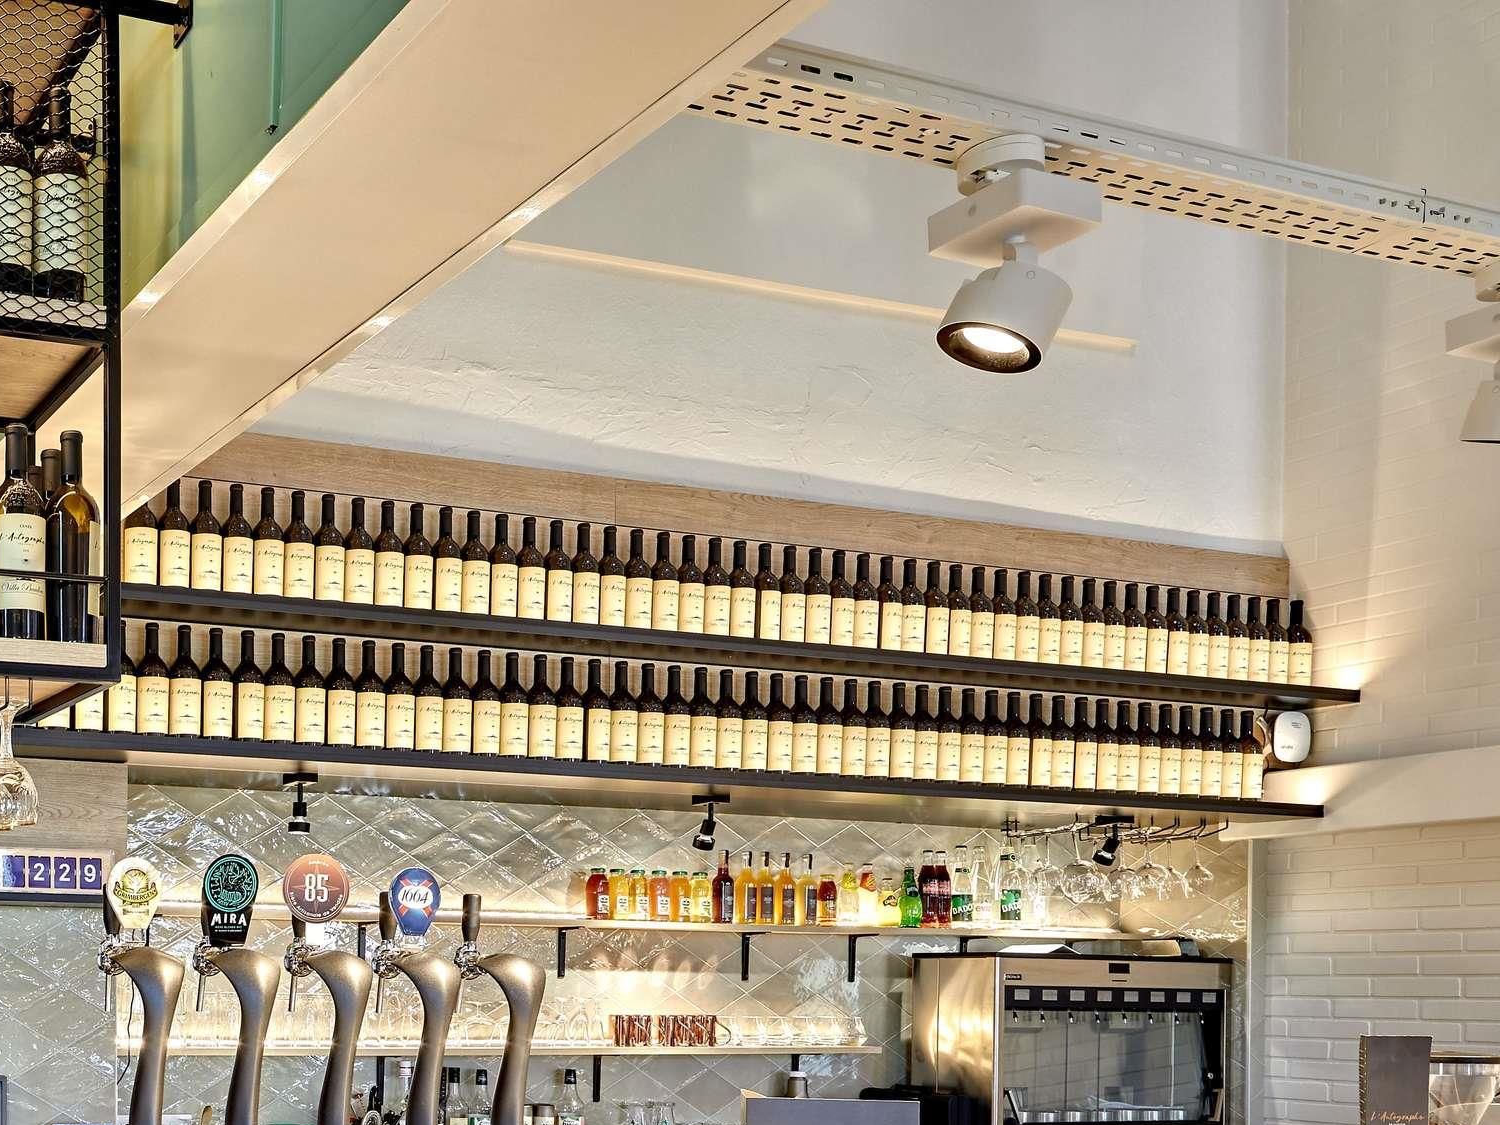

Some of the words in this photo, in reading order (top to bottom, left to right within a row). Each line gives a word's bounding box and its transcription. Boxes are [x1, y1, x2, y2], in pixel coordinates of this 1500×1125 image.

[116, 889, 155, 901] GRIMBERGEN
[304, 873, 329, 903] 85
[400, 891, 430, 904] 1664
[210, 913, 247, 927] MIRA
[1371, 1111, 1425, 1125] L'Autographe
